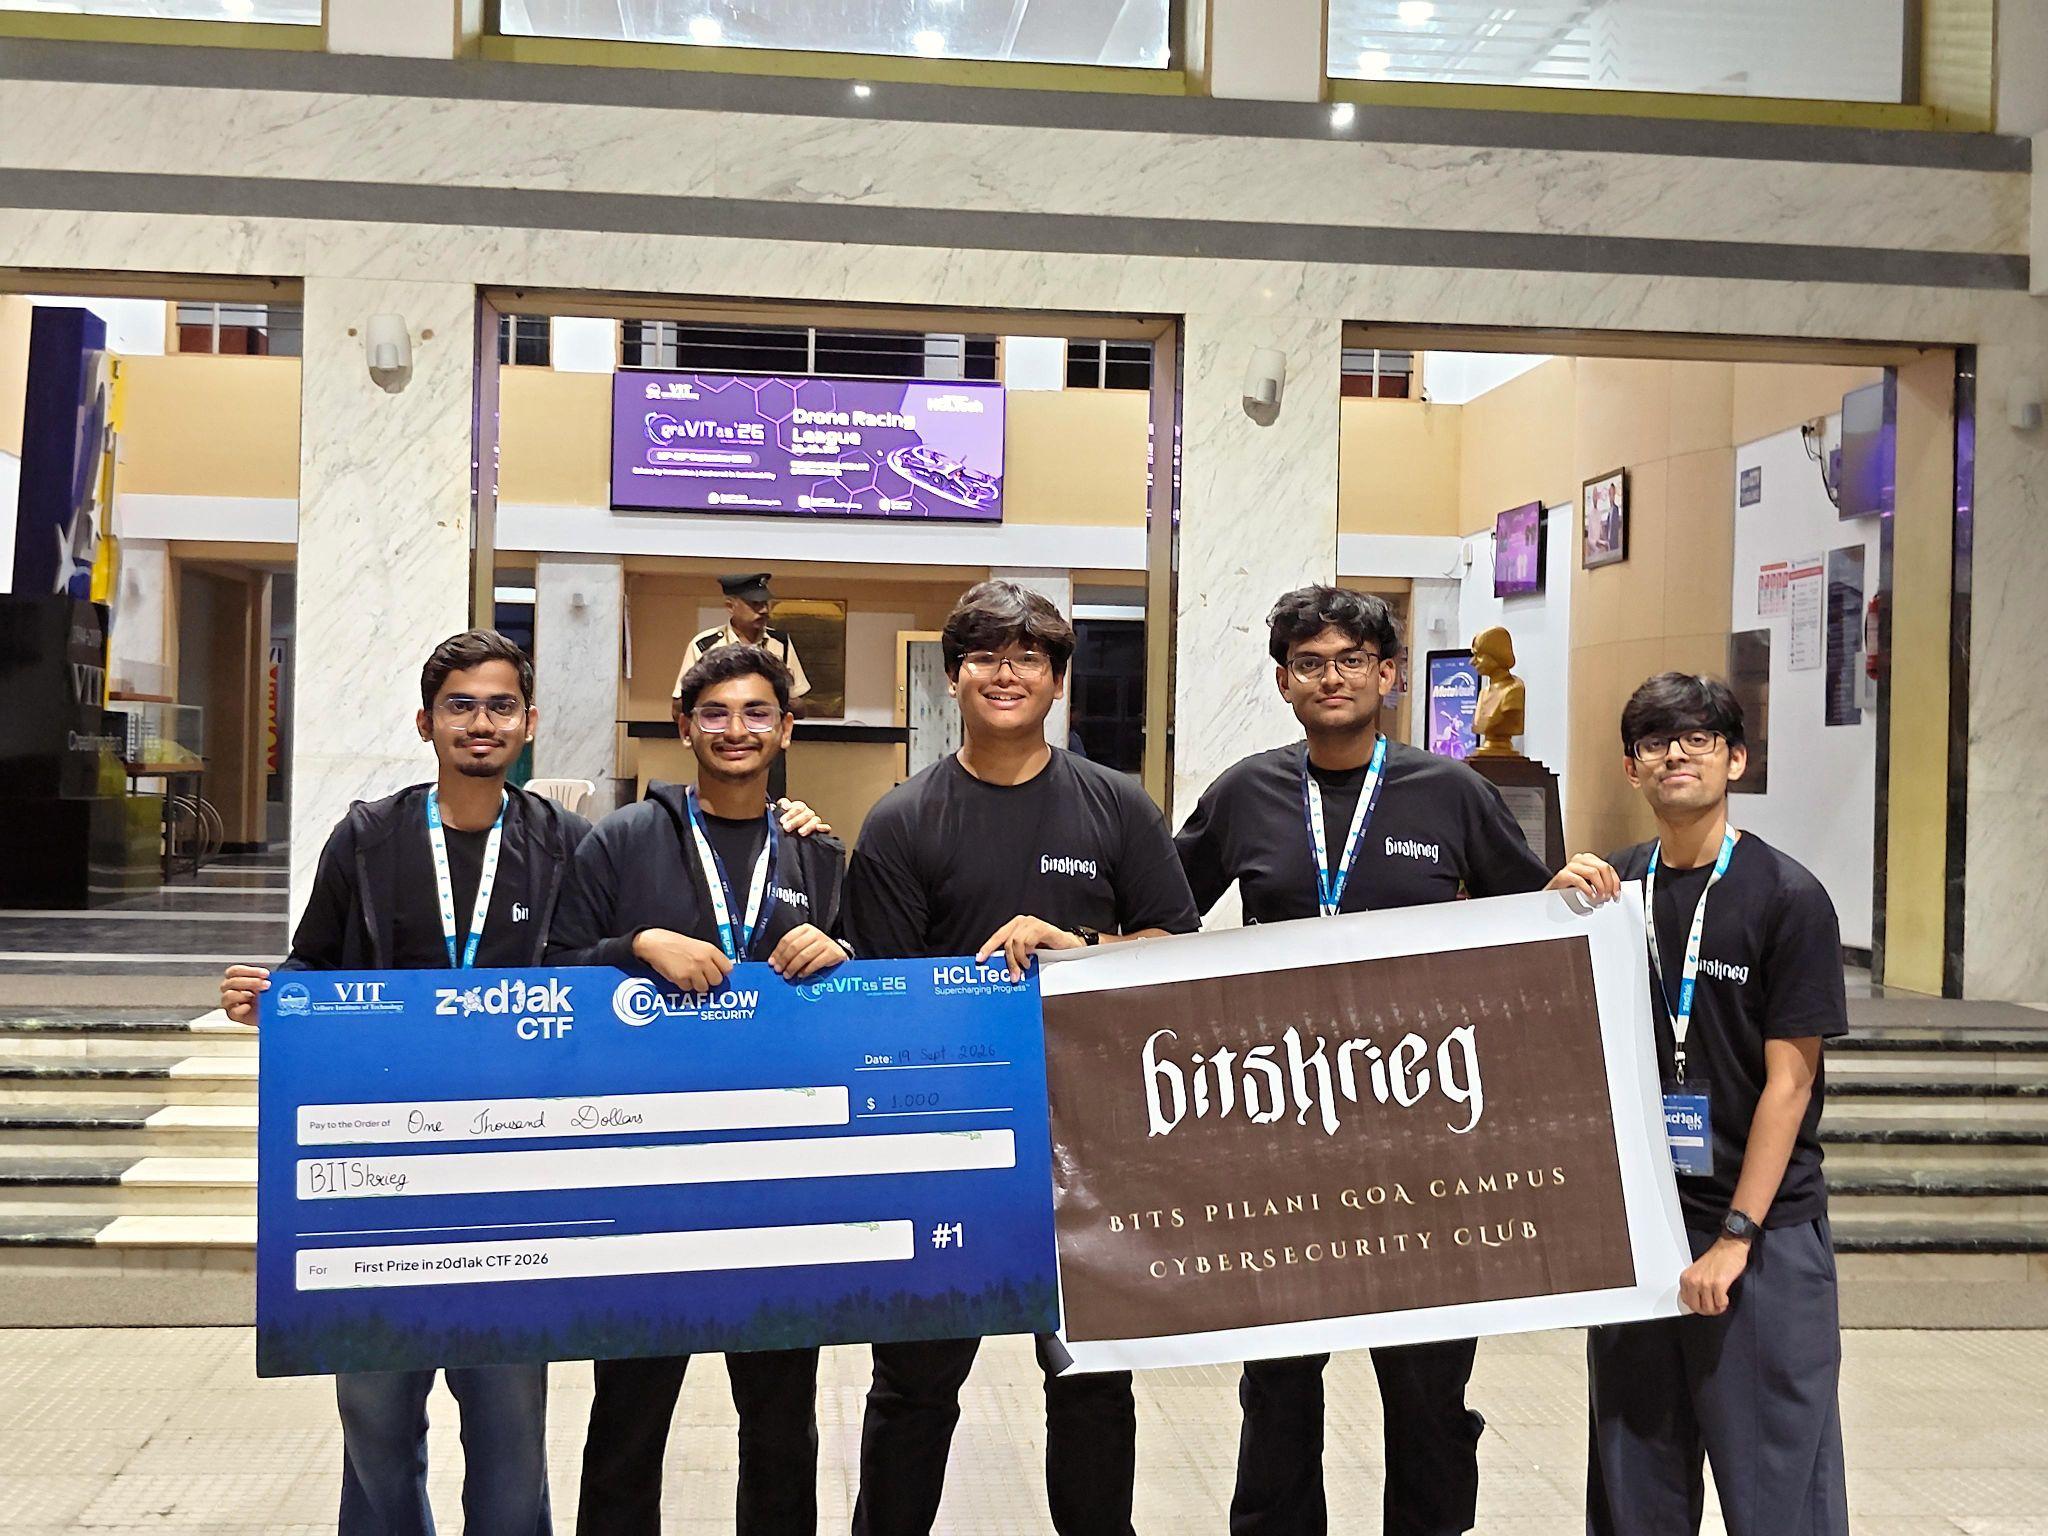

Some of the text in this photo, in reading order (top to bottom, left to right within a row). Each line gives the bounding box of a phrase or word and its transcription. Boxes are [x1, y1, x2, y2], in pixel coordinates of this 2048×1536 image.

[793, 408, 916, 431] Drone Racing
[792, 427, 862, 446] League
[1698, 958, 1750, 986] itskrieg
[334, 981, 387, 1002] VIT
[635, 990, 760, 1012] DATAFLOW
[934, 985, 992, 996] Supercharging
[700, 1009, 755, 1021] SECURITY
[516, 1016, 574, 1040] CTF
[864, 1054, 893, 1065] Date:
[898, 1049, 910, 1064] 19
[959, 1044, 996, 1060] 2026
[1142, 1024, 1484, 1139] bitskrieg
[866, 1097, 876, 1111] $
[309, 1119, 391, 1131] Pay to the Order of
[407, 1104, 643, 1136] One Thousand Dollars
[309, 1161, 410, 1194] BITSkrieg
[1108, 1166, 1566, 1233] BITS PILANI GOA CAMPUS
[931, 1222, 965, 1249] #1
[1149, 1218, 1538, 1279] CYBERSECURITY CLUB
[308, 1264, 328, 1276] For
[354, 1252, 549, 1274] First Prize in z0d1ak CTF 2026
